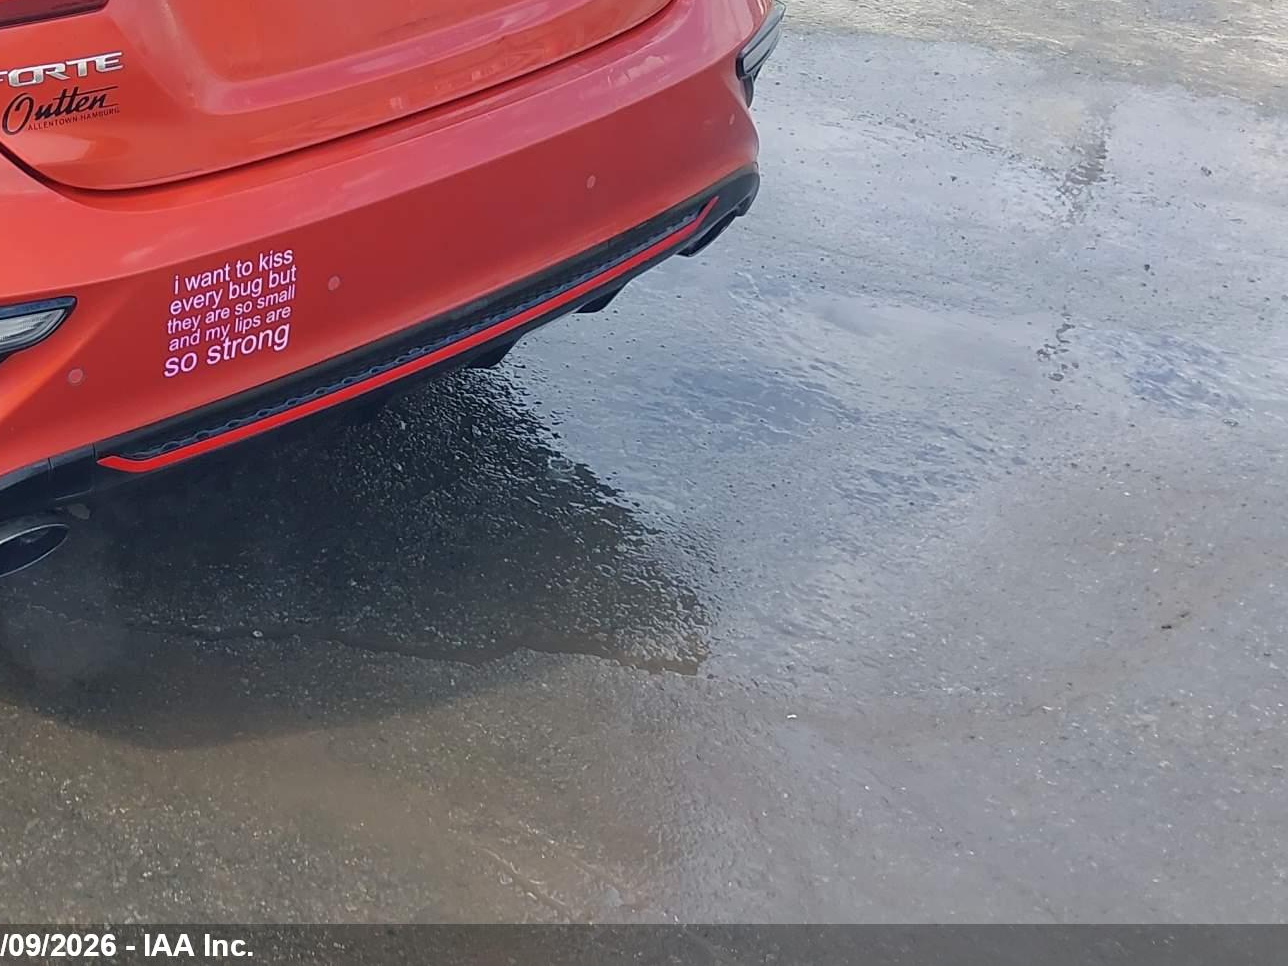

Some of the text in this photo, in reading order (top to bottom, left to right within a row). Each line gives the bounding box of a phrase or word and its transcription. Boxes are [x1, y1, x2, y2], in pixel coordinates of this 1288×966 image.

[2, 85, 119, 135] Outten
[28, 114, 78, 131] ALLENTOWN
[170, 264, 297, 315] every bug but
[174, 249, 293, 295] i want to kiss
[167, 285, 296, 334] they are so small
[169, 306, 291, 351] and my lips are
[164, 323, 290, 377] so strong
